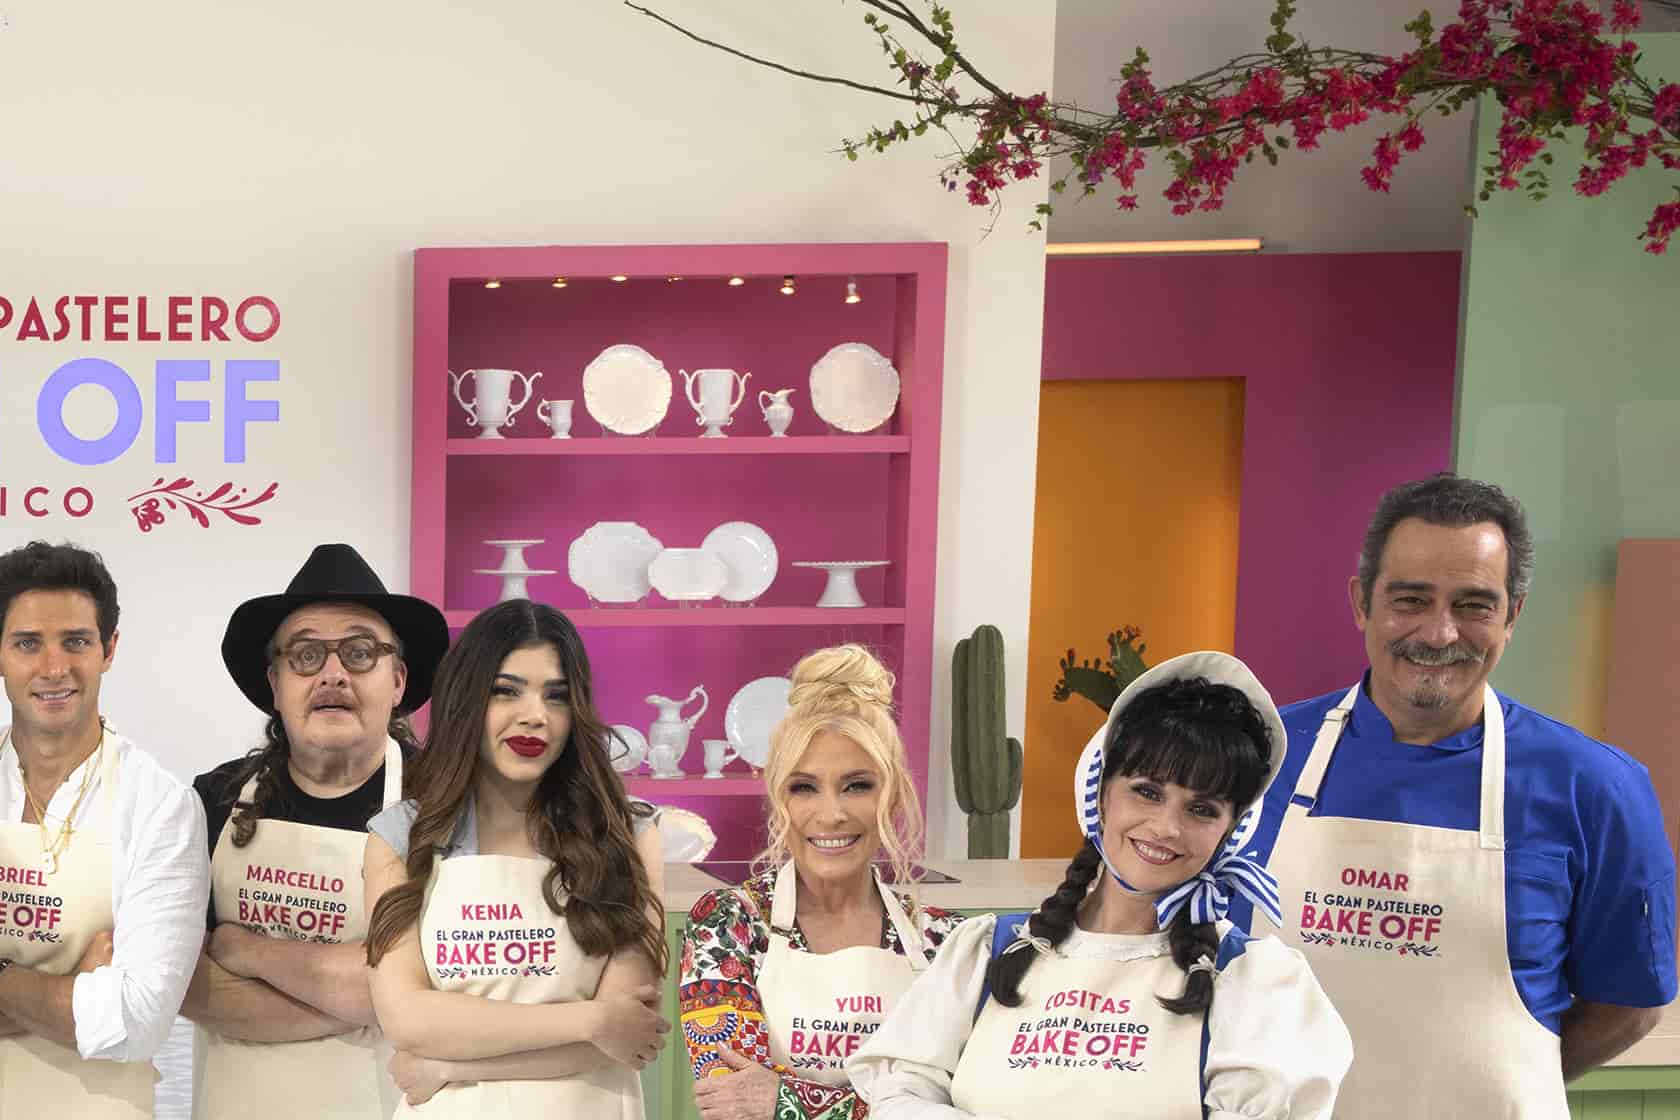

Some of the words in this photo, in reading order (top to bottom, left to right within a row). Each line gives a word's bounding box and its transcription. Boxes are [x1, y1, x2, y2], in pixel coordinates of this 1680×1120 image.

[36, 357, 280, 466] OFF
[247, 865, 344, 893] MARCELLO
[1342, 868, 1408, 892] OMAR
[2, 891, 62, 907] PASTELERO
[239, 888, 248, 899] EL
[253, 890, 282, 904] GRAN
[286, 895, 347, 913] PASTELERO
[1305, 891, 1318, 903] EL
[1324, 894, 1361, 908] GRAN
[1367, 899, 1443, 916] PASTELERO
[13, 906, 61, 929] OFF
[239, 901, 291, 926] BAKE
[297, 910, 345, 935] OFF
[462, 904, 523, 920] KENIA
[1302, 905, 1373, 936] BAKE
[1380, 915, 1441, 942] OFF
[437, 930, 447, 941] EL
[452, 930, 483, 941] GRAN
[489, 928, 555, 940] PASTELERO
[1341, 936, 1393, 950] MÉXICO
[437, 943, 496, 965] BAKE
[504, 941, 556, 964] OFF
[472, 966, 518, 975] MÉXICO
[836, 996, 881, 1013] YURI
[793, 1018, 806, 1029] EL
[812, 1020, 848, 1032] GRAN
[1019, 1022, 1032, 1032] EL
[1037, 1017, 1069, 1031] GRAN
[1074, 1018, 1149, 1034] PASTELERO
[1010, 1030, 1080, 1056] BAKE
[1086, 1034, 1147, 1057] OFF
[1045, 1056, 1098, 1067] MÉXICO
